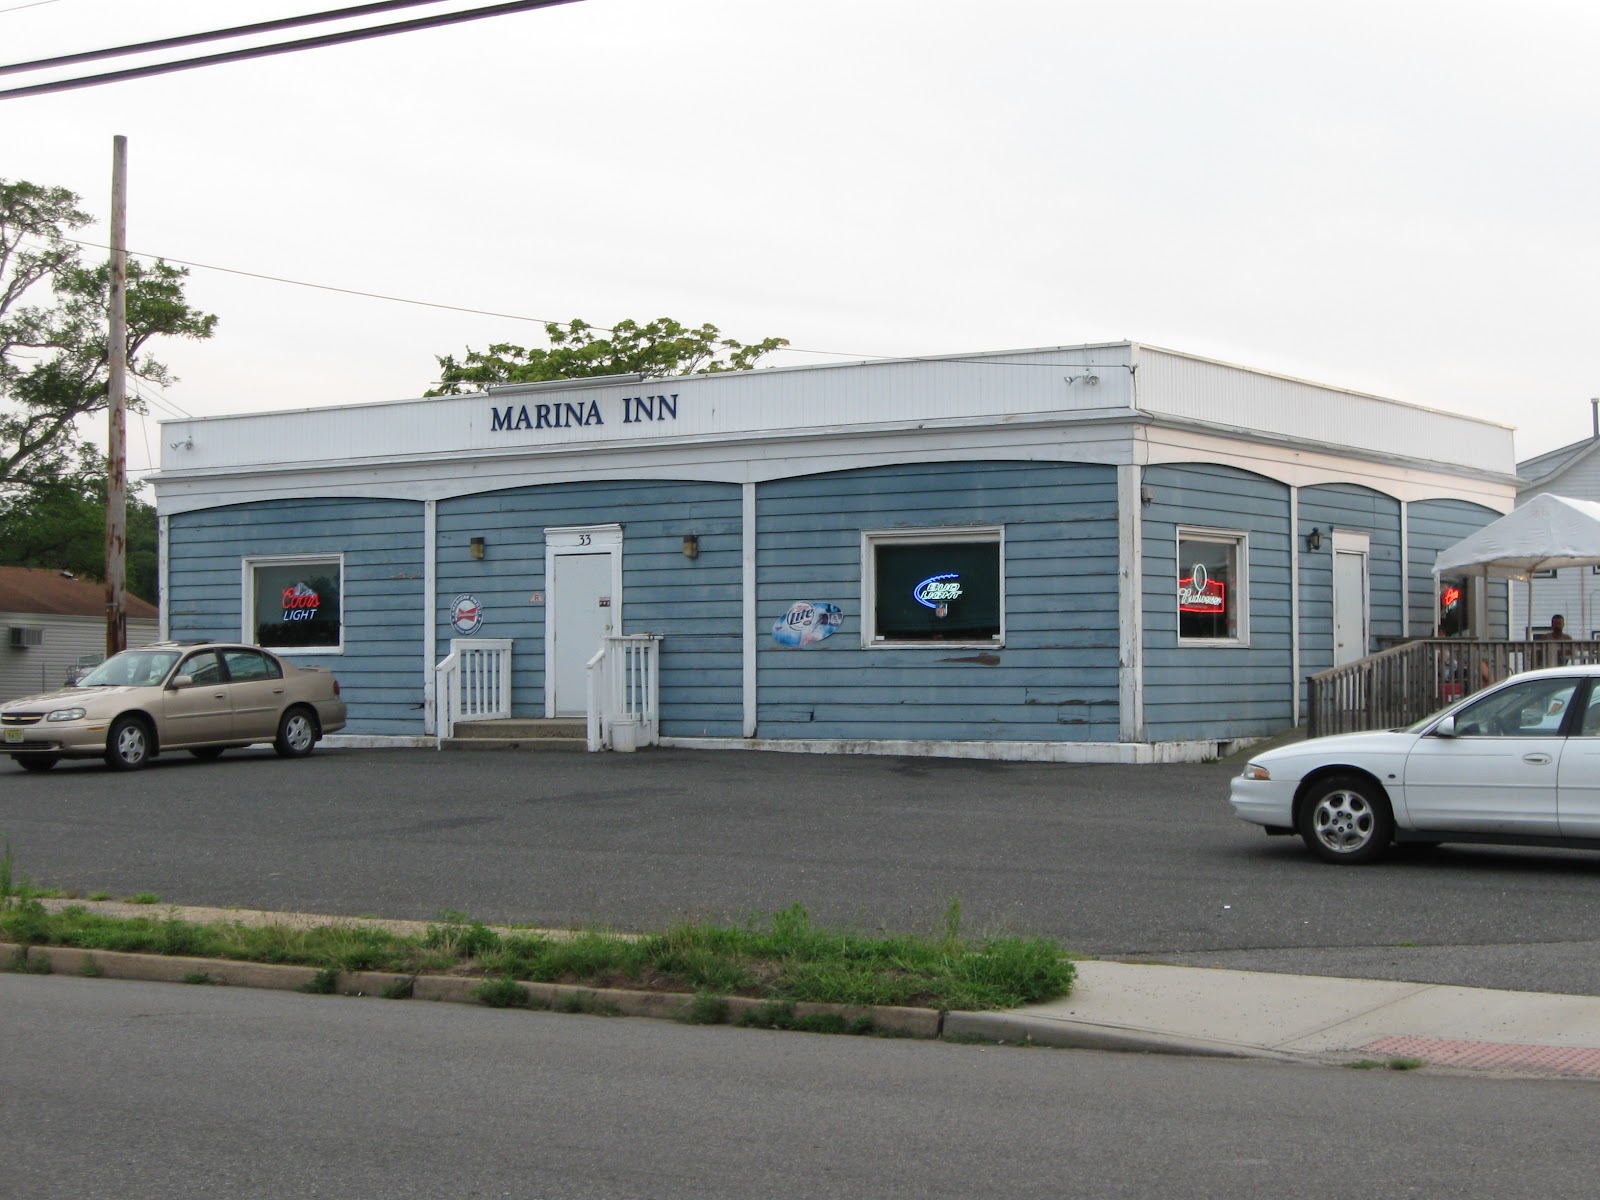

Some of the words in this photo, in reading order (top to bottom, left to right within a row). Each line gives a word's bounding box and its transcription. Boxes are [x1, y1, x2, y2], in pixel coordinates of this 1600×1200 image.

[490, 400, 604, 432] MARINA
[622, 394, 679, 424] INN
[579, 534, 591, 546] 33
[282, 586, 320, 608] Coors
[283, 609, 317, 621] LIGHT
[789, 608, 814, 626] Lite
